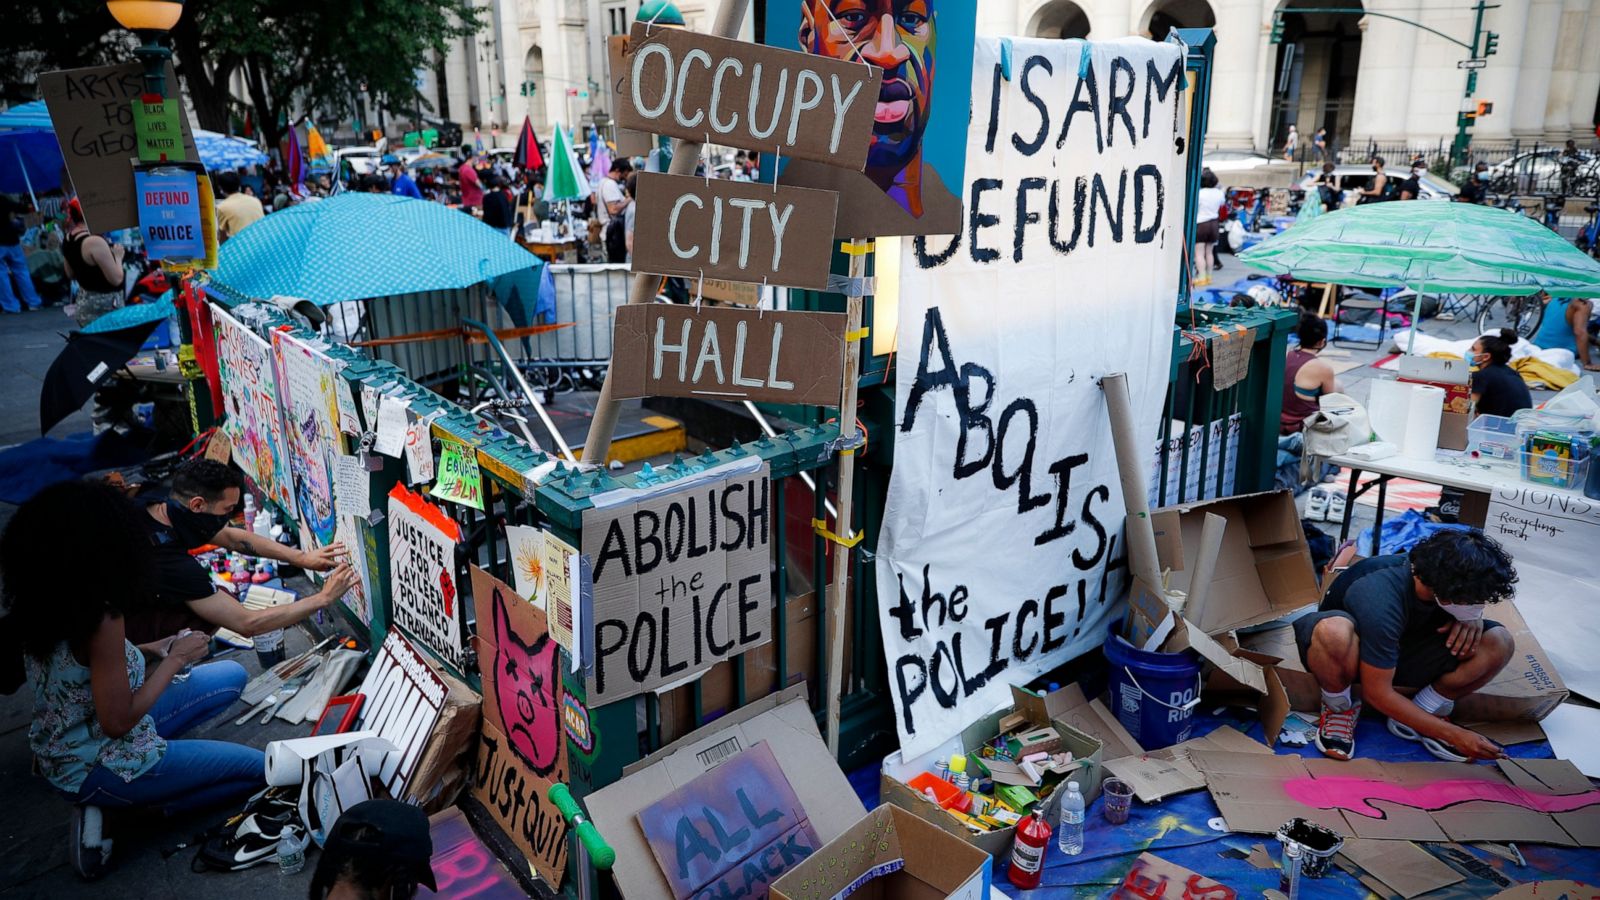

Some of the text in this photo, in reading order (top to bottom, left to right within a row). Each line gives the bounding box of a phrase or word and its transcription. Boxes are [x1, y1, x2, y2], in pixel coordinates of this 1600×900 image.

[102, 102, 134, 127] FO
[144, 104, 165, 114] BLACK
[631, 42, 863, 154] OCCUPY
[146, 138, 175, 149] MATTER
[147, 121, 167, 131] LIVES
[145, 191, 190, 206] DEFUND
[148, 225, 194, 241] POLICE
[668, 193, 794, 272] CITY
[652, 316, 795, 391] HALL
[395, 517, 444, 567] JUSTICE
[593, 477, 769, 584] ABOLISH
[396, 560, 444, 613] LAYLEEN
[410, 549, 431, 581] FOR
[654, 571, 705, 605] the
[399, 583, 449, 638] POLANCO
[889, 563, 968, 643] the
[594, 574, 762, 695] POLICE
[895, 578, 1086, 735] POLICE!
[565, 705, 587, 740] ACAB
[1170, 688, 1193, 707] DO
[675, 787, 785, 879] ALL
